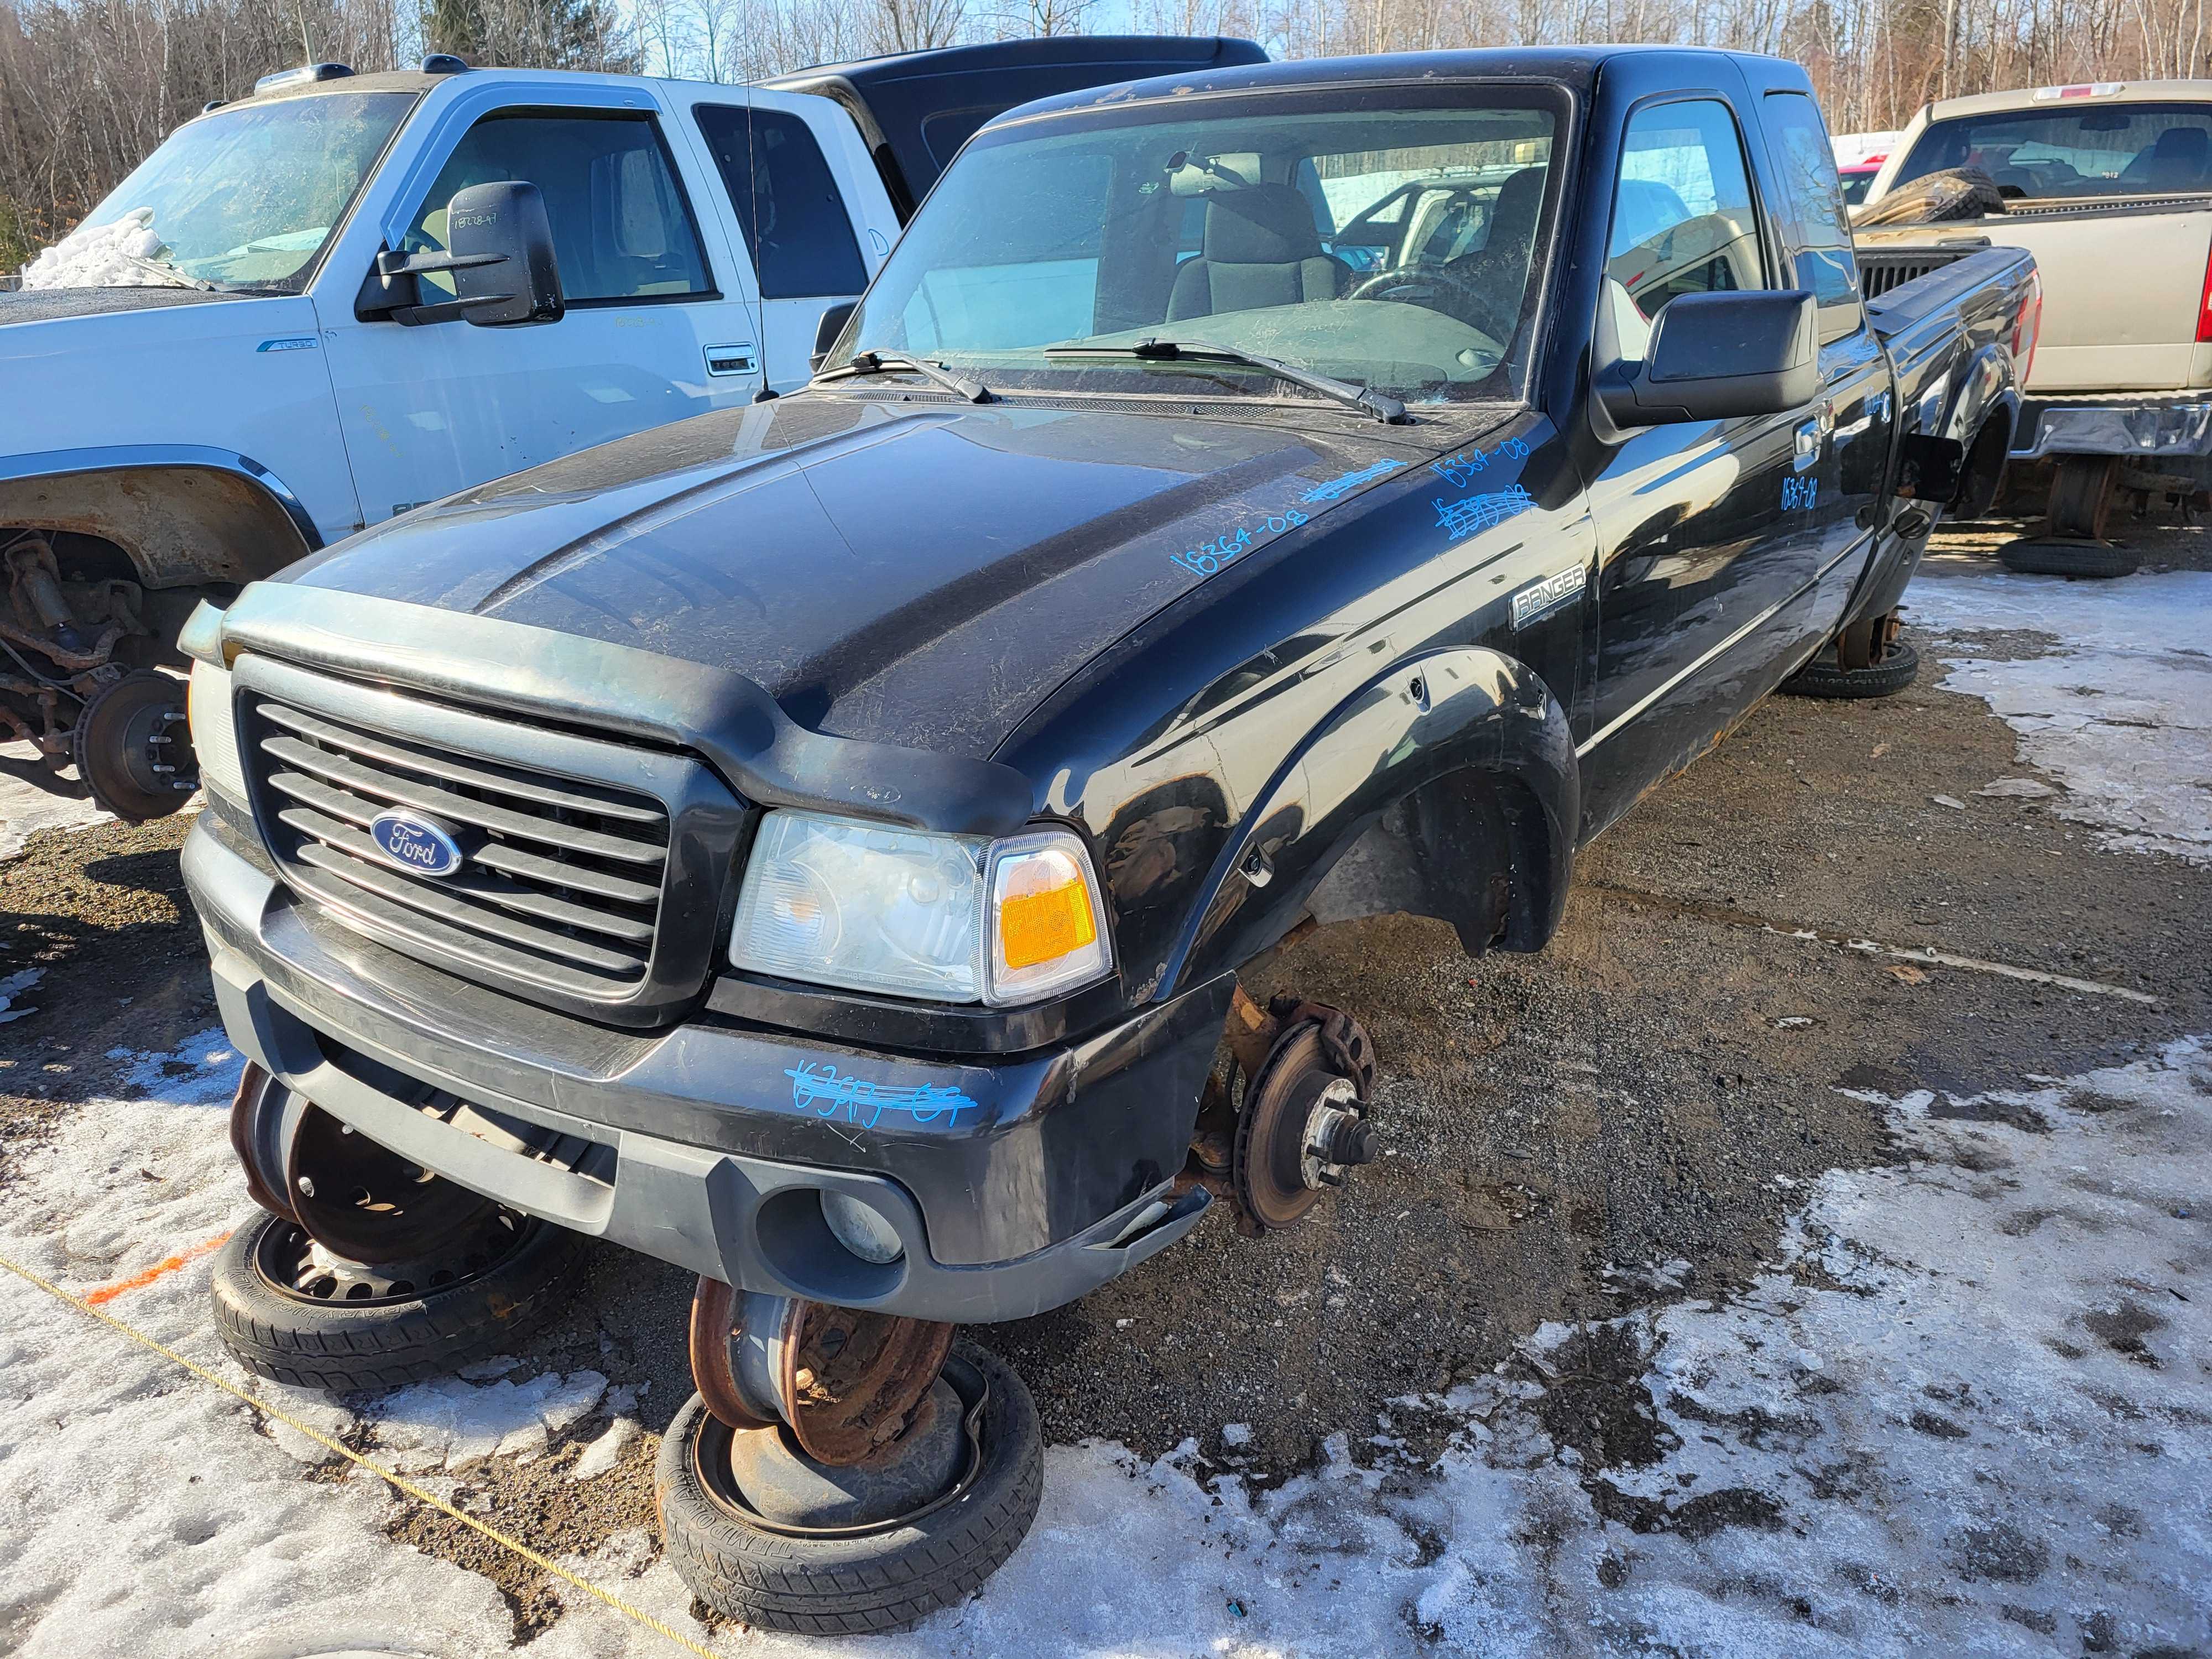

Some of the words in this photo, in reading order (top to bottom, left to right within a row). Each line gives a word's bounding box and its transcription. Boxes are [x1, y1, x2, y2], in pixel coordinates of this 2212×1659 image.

[278, 340, 313, 349] TURBO
[1516, 566, 1585, 618] RANGER
[389, 823, 436, 865] Ford
[227, 1271, 266, 1300] ONLY
[663, 1463, 794, 1559] TEMPORARY
